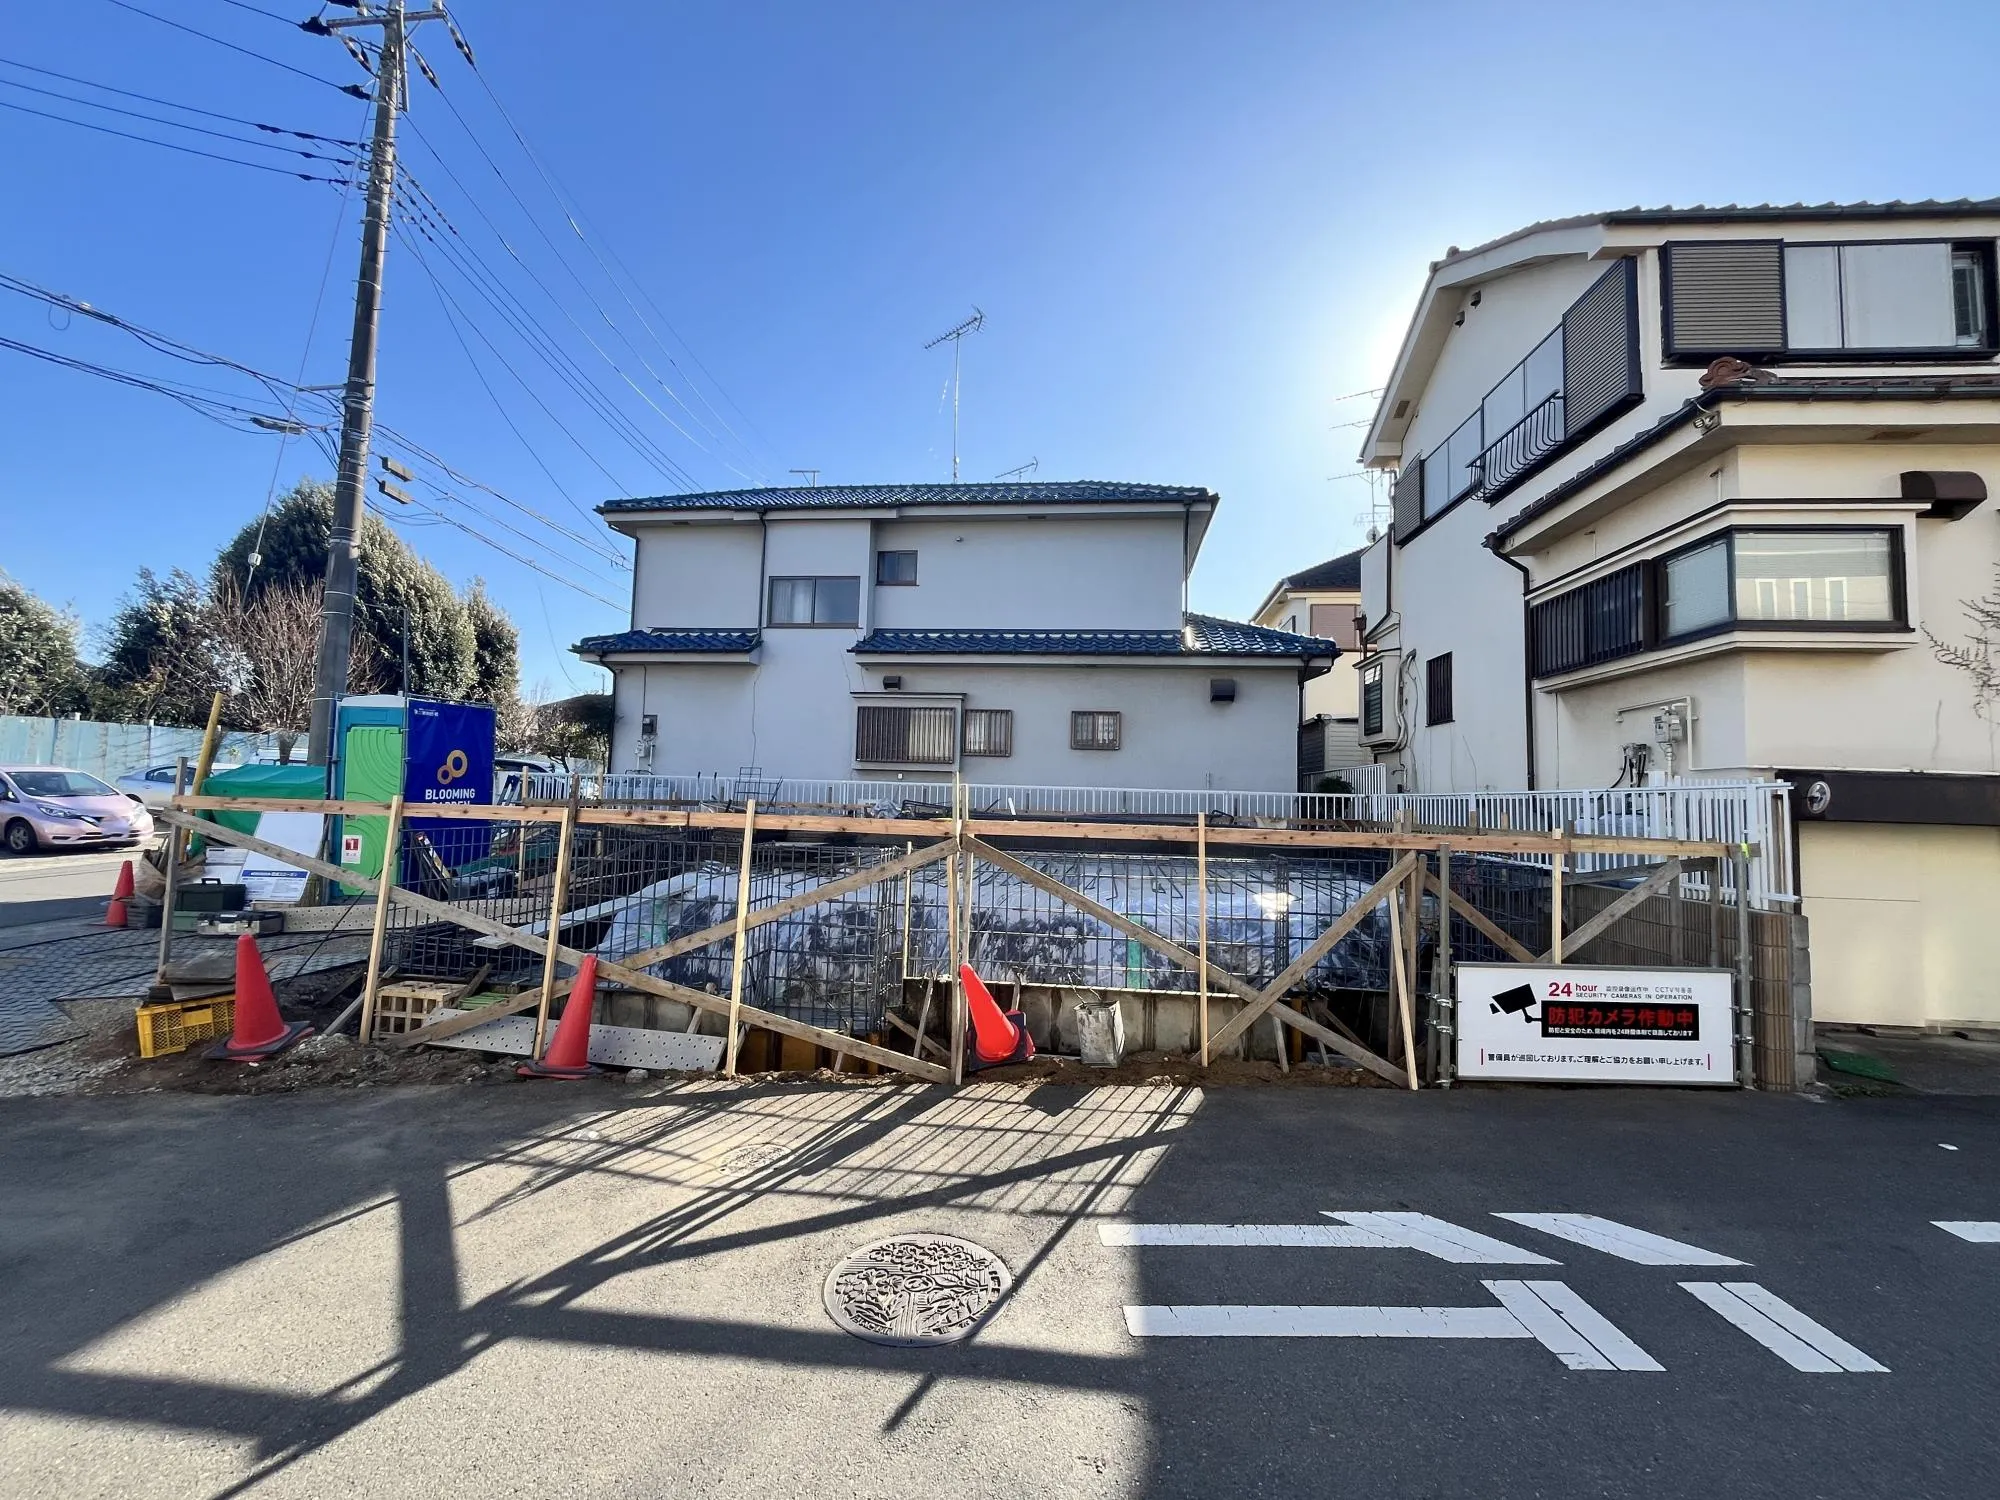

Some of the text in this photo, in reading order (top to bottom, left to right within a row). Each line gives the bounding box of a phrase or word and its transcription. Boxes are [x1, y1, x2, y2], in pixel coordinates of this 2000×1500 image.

[425, 788, 475, 800] BLOOMING
[1548, 982, 1572, 997] 24
[1575, 983, 1598, 992] hour
[1548, 1006, 1693, 1027] 防犯カメラ作動中
